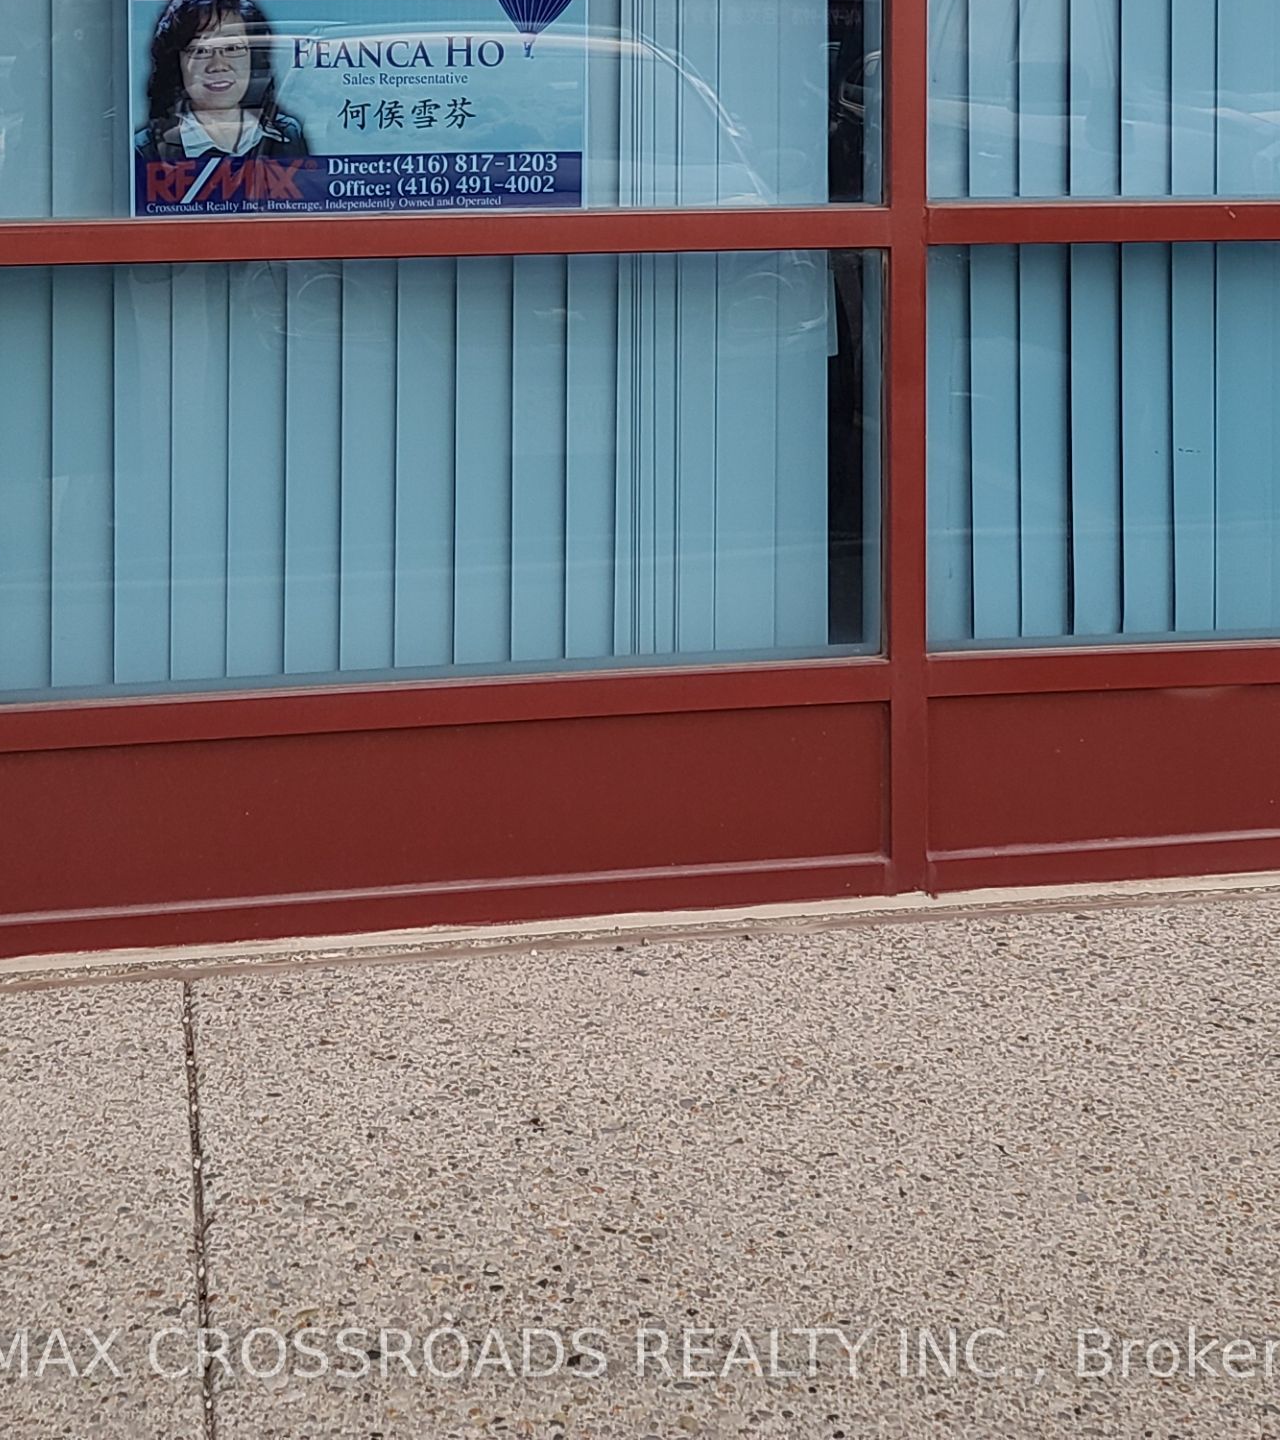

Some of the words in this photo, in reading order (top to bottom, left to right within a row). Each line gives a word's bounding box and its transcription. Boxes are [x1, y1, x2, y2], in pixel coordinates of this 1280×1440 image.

[291, 37, 435, 69] FEANCA
[342, 72, 376, 86] Sales
[379, 72, 469, 88] Representative
[337, 96, 477, 130] 何侯雪芬
[454, 153, 558, 174] 817-1203
[328, 179, 392, 197] Office:
[397, 176, 450, 196] (416)
[455, 175, 555, 194] 491-4002
[146, 202, 203, 214] Crossroads
[206, 201, 239, 213] Realty
[325, 198, 396, 211] Independently
[398, 197, 435, 208] Owned
[436, 196, 455, 207] and
[456, 196, 502, 208] Operated
